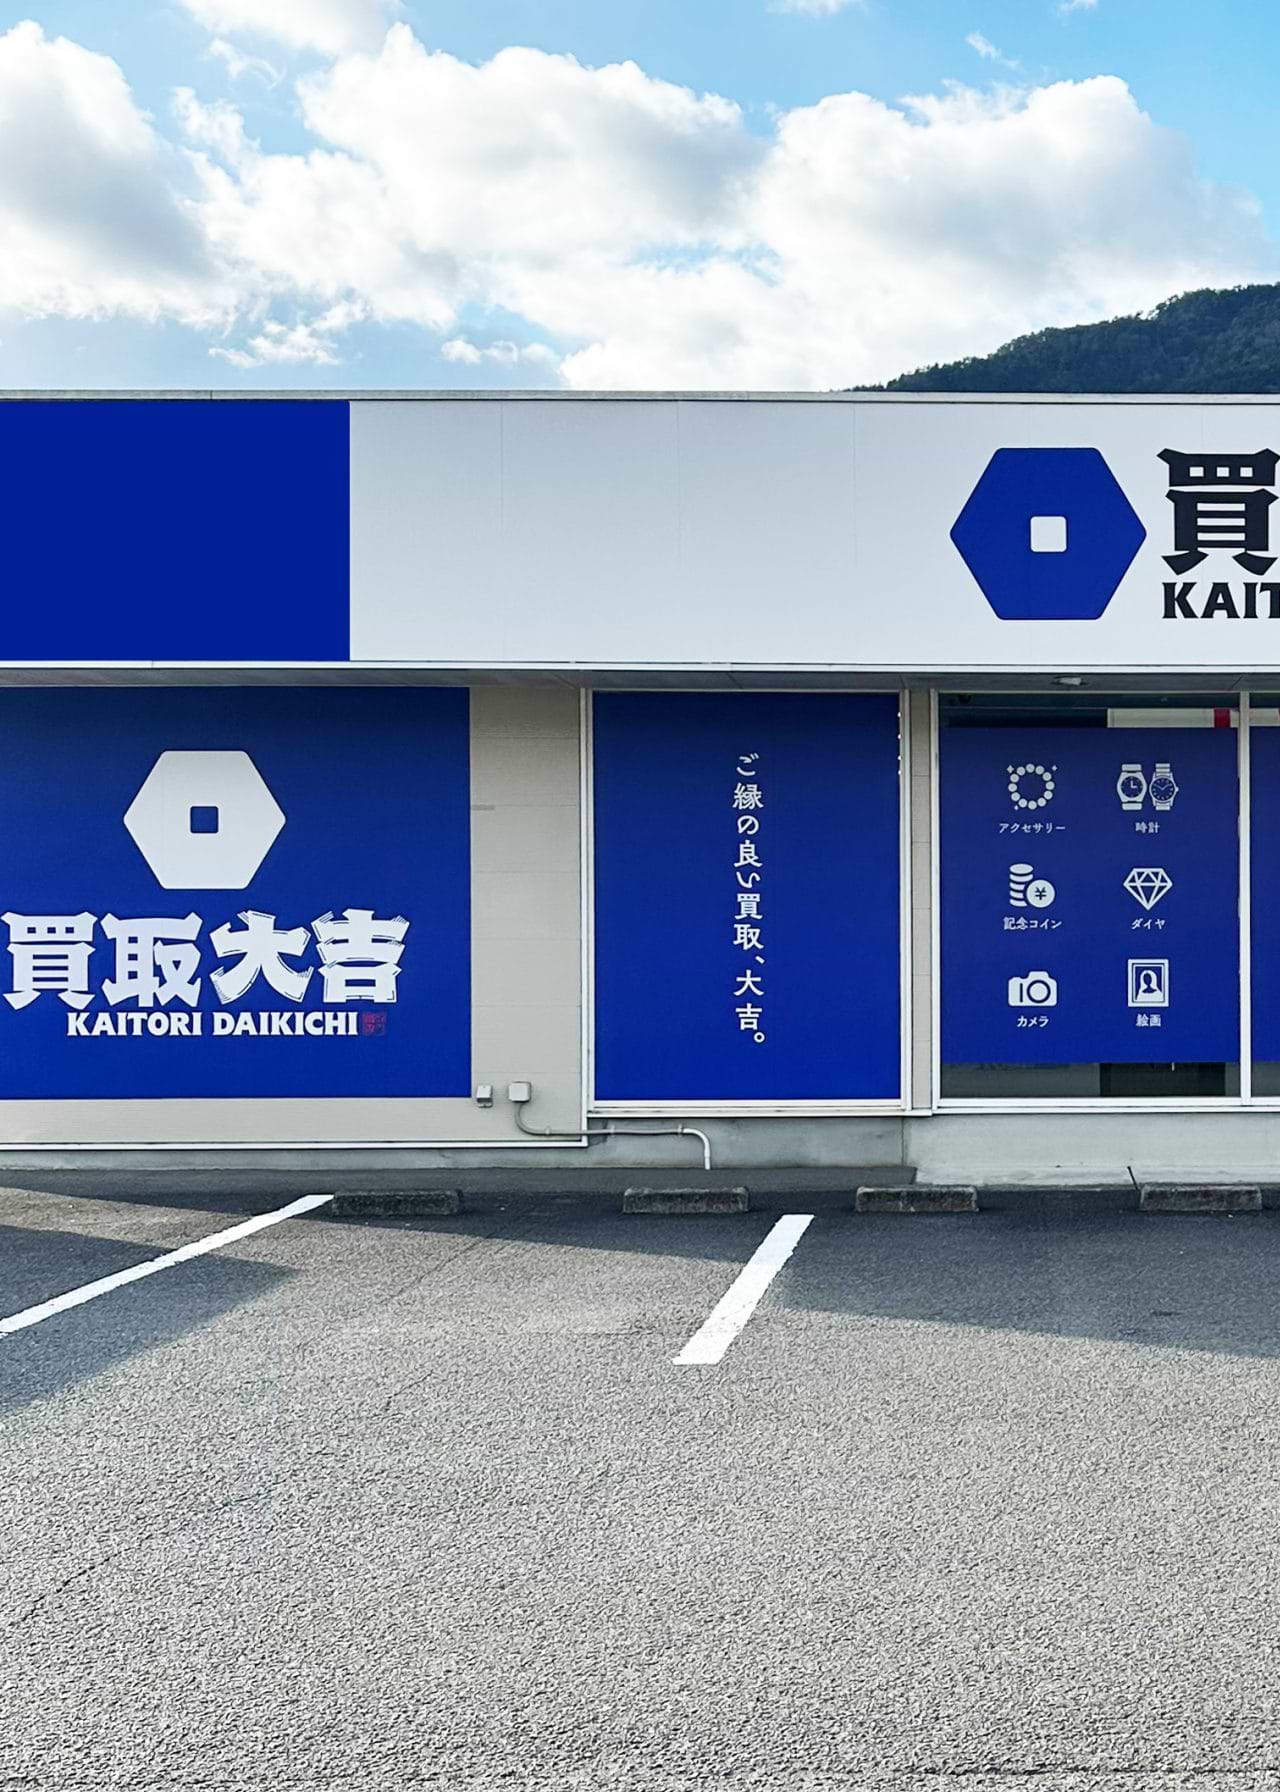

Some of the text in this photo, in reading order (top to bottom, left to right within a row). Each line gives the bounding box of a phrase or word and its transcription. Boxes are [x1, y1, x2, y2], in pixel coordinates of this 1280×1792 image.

[998, 821, 1066, 834] アクセサリー
[1135, 821, 1160, 834] 時計
[732, 753, 765, 1043] ご縁の良い買取、大吉。
[1003, 916, 1062, 931] 記念コイン
[1131, 917, 1166, 930] ダイヤ
[1, 908, 410, 1009] 買取大吉
[67, 1011, 202, 1036] KAITORI
[212, 1011, 358, 1036] DAIKICHI
[1017, 1015, 1049, 1028] カメラ
[1135, 1013, 1162, 1027] 絵画
